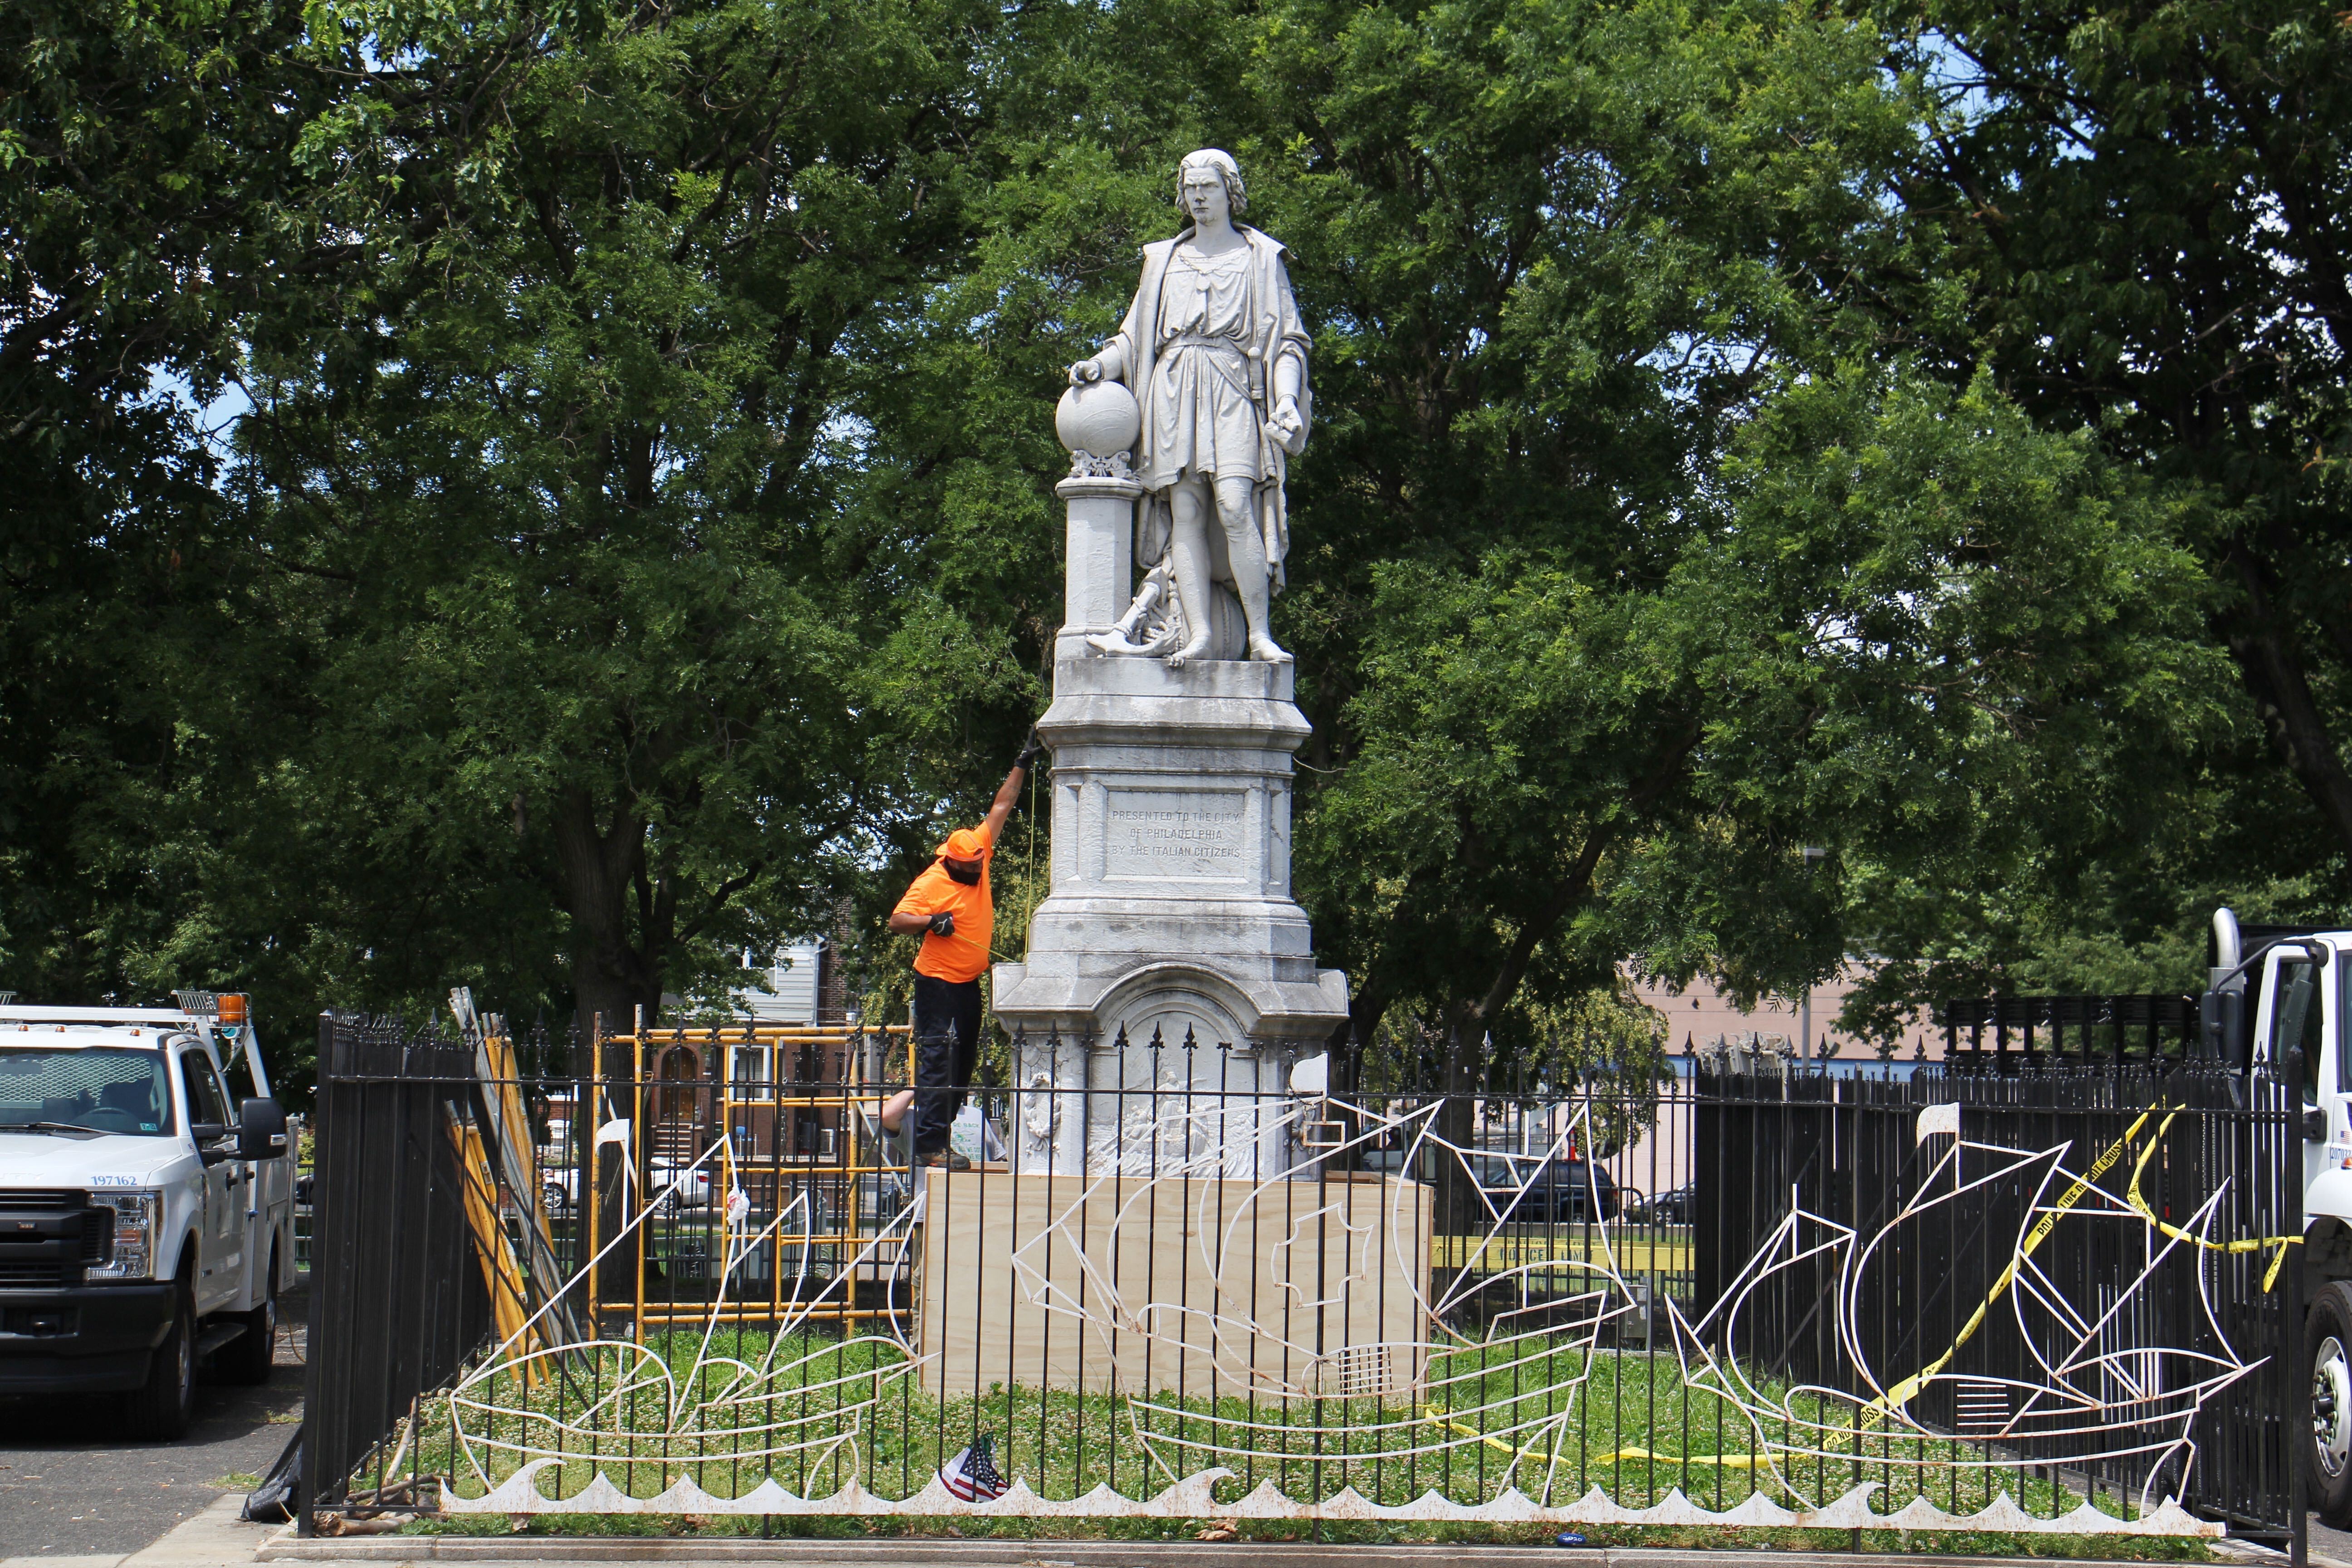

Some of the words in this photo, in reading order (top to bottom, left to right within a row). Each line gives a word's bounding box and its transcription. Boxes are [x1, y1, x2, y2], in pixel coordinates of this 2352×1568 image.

[1112, 811, 1172, 821] PRESENTED
[1176, 812, 1189, 822] TO
[1193, 813, 1211, 822] THE
[1215, 813, 1240, 823] CITY
[1130, 828, 1142, 838] OF
[1147, 829, 1222, 840] PHILADELPHIA
[1112, 846, 1125, 856] BY
[1129, 846, 1148, 856] THE
[1152, 847, 1191, 857] ITALIAN
[1194, 848, 1241, 858] CITIZENS
[91, 1176, 137, 1186] 197162
[1860, 1407, 1880, 1427] ROSS
